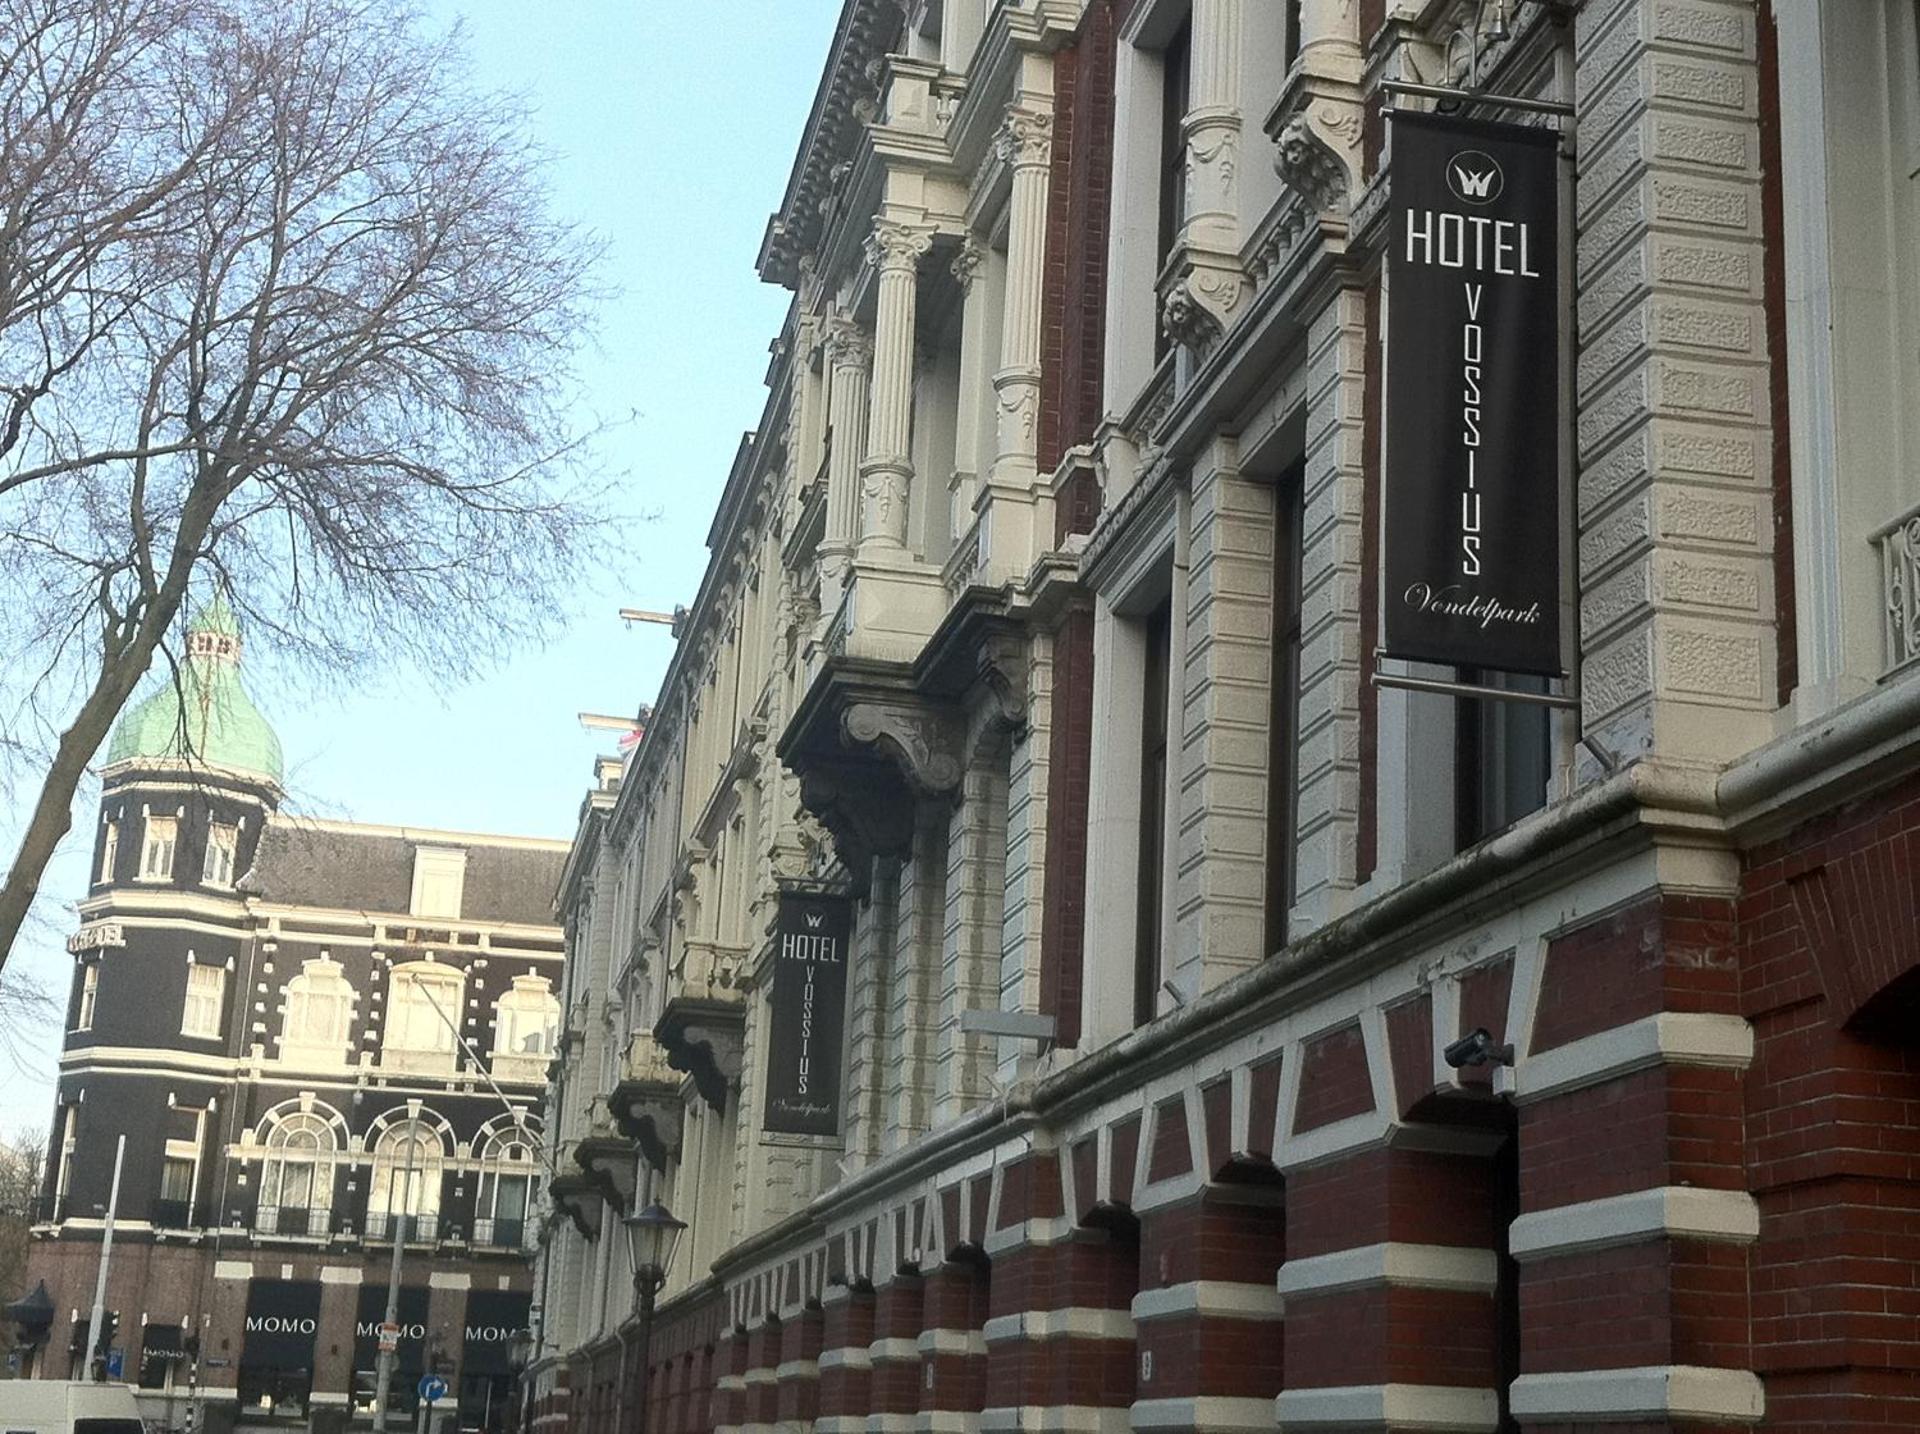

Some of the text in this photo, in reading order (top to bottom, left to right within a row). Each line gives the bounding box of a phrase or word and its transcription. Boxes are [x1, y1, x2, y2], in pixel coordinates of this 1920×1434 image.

[1407, 209, 1540, 277] HOTEL
[1463, 283, 1482, 575] VOSSIUS
[1404, 583, 1540, 628] Vondelpark
[782, 933, 840, 963] HOTEL
[798, 965, 815, 1094] VOSSIUS
[246, 1316, 316, 1334] MOMO
[465, 1326, 530, 1341] MOM
